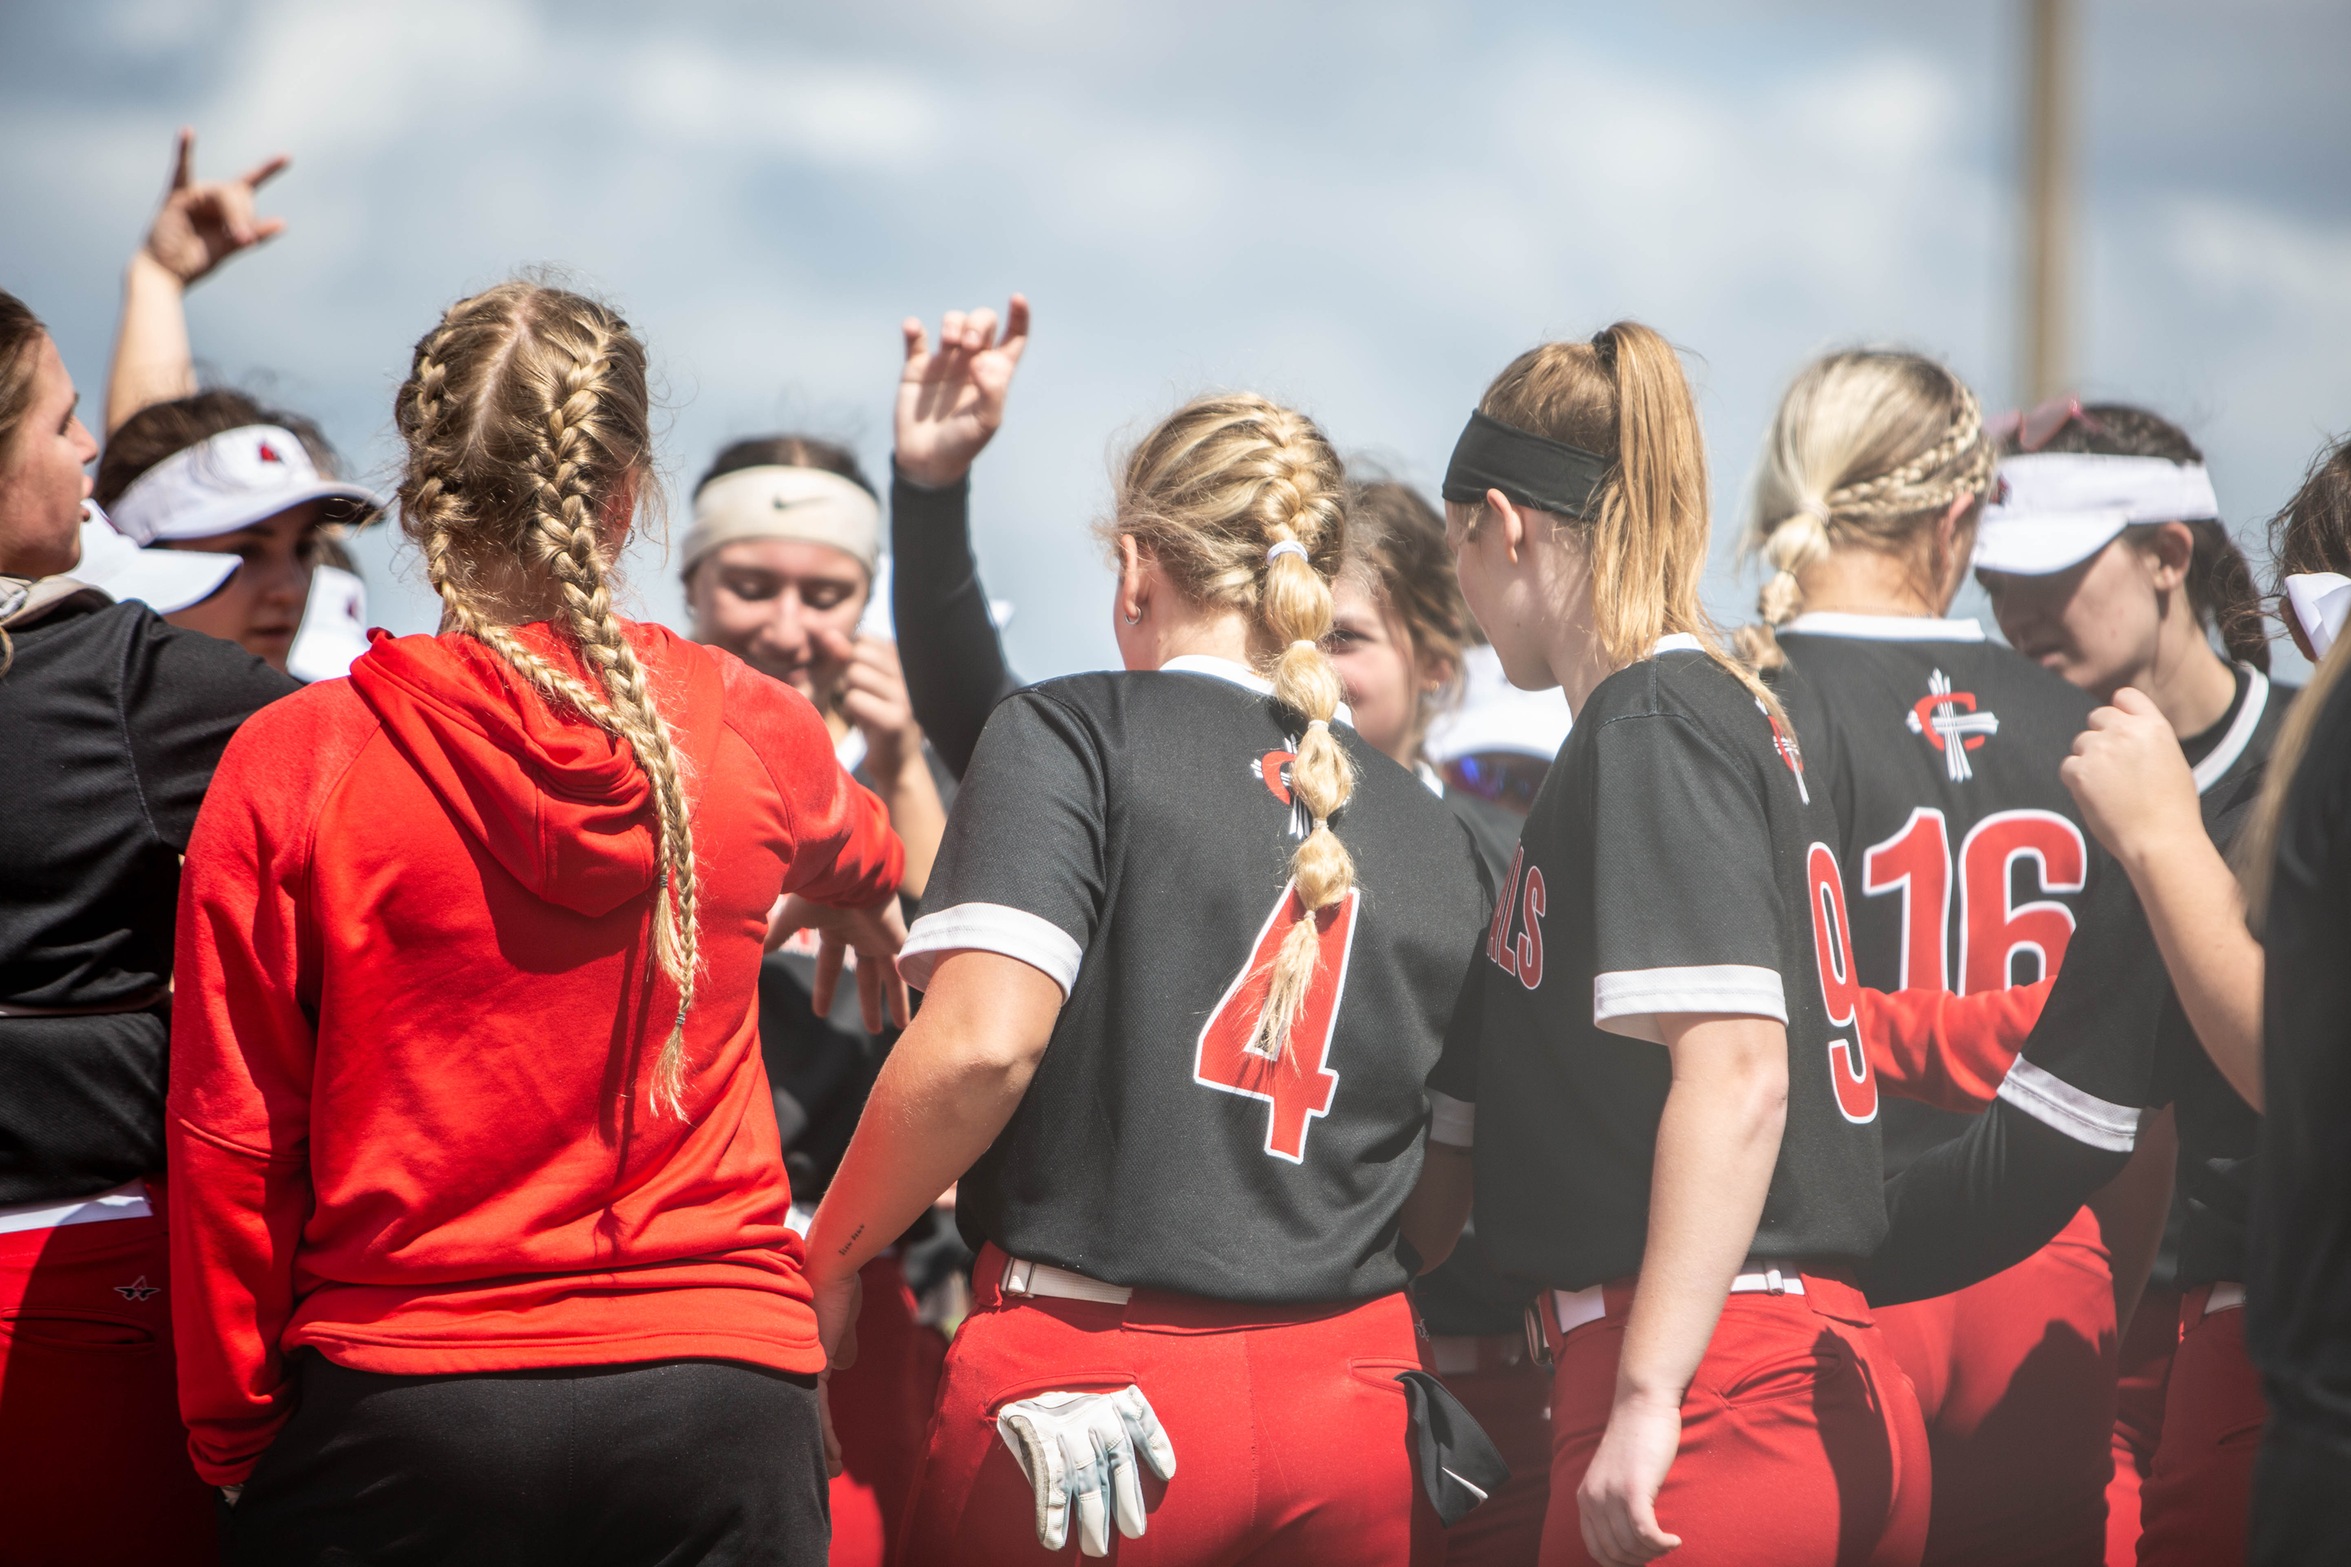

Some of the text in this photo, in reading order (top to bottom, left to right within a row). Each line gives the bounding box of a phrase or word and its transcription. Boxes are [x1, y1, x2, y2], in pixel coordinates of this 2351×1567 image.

[1194, 875, 1361, 1165] 4
[1807, 841, 1879, 1124] 9
[1862, 806, 2088, 999] 16
